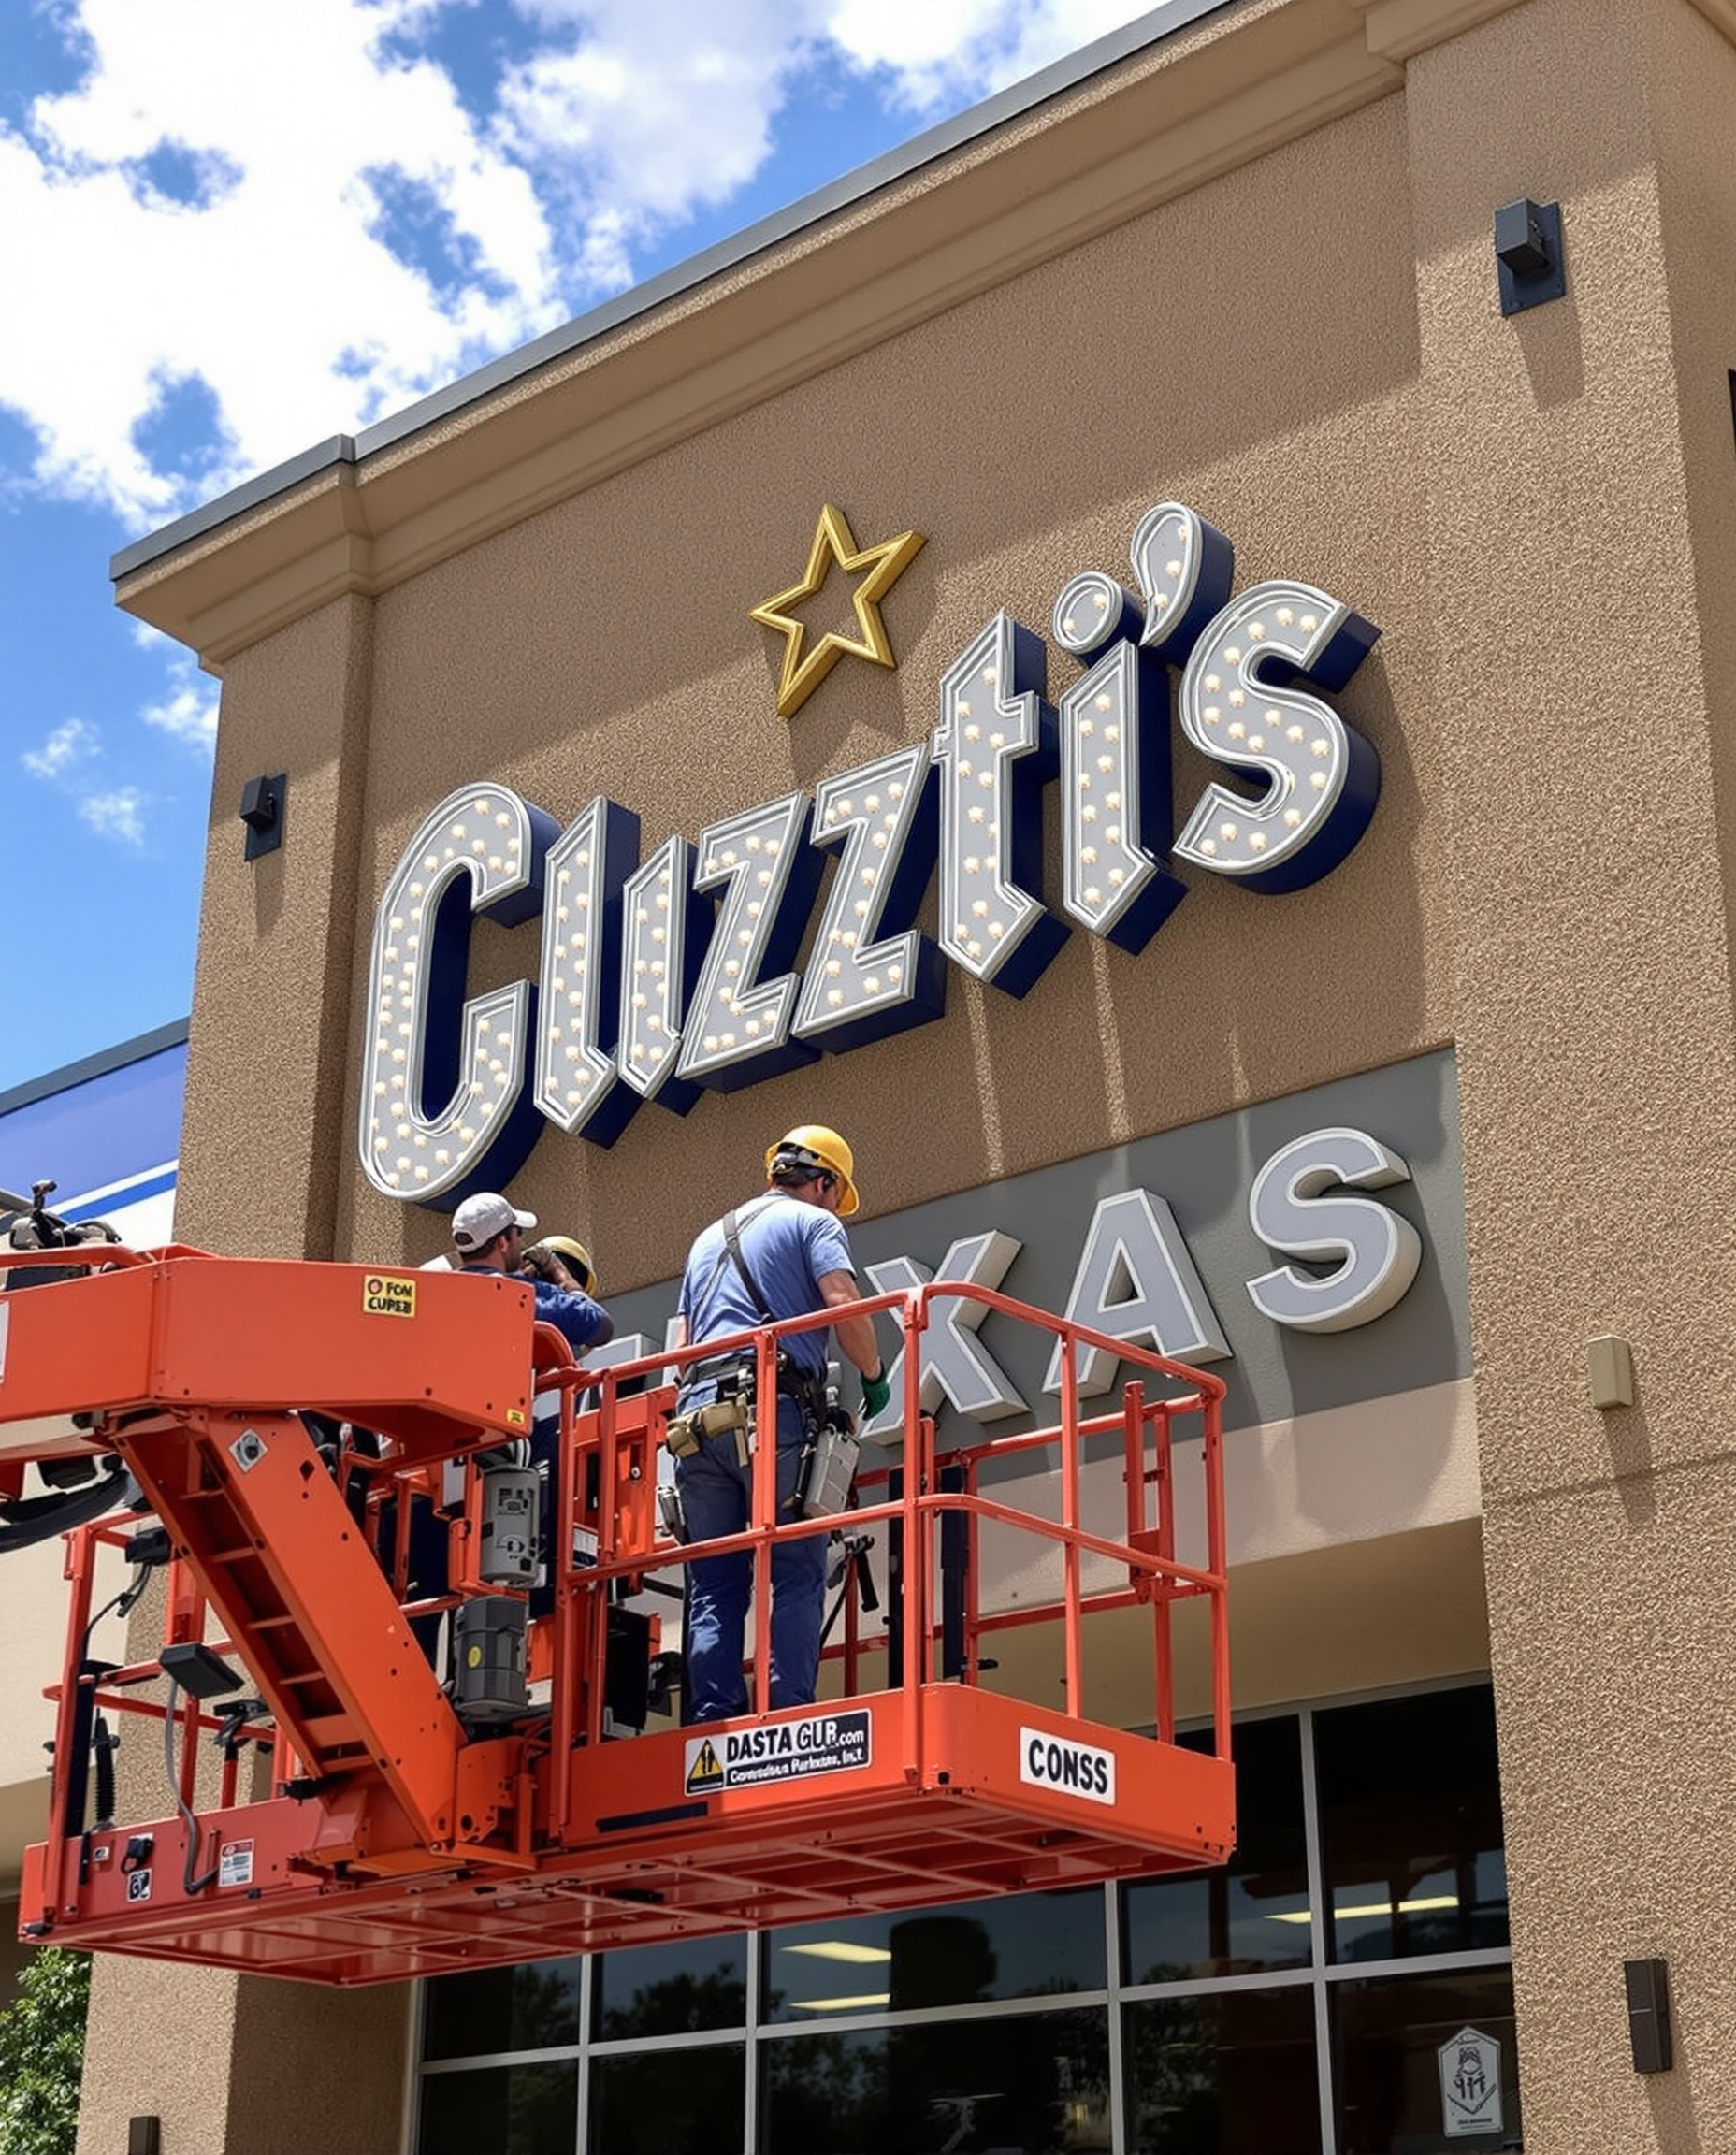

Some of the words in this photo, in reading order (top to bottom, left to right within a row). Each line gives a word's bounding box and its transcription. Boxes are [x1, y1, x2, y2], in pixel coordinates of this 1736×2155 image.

[580, 1126, 1423, 1446] XAS
[727, 1726, 792, 1763] DASTA
[1029, 1739, 1107, 1794] CONSS
